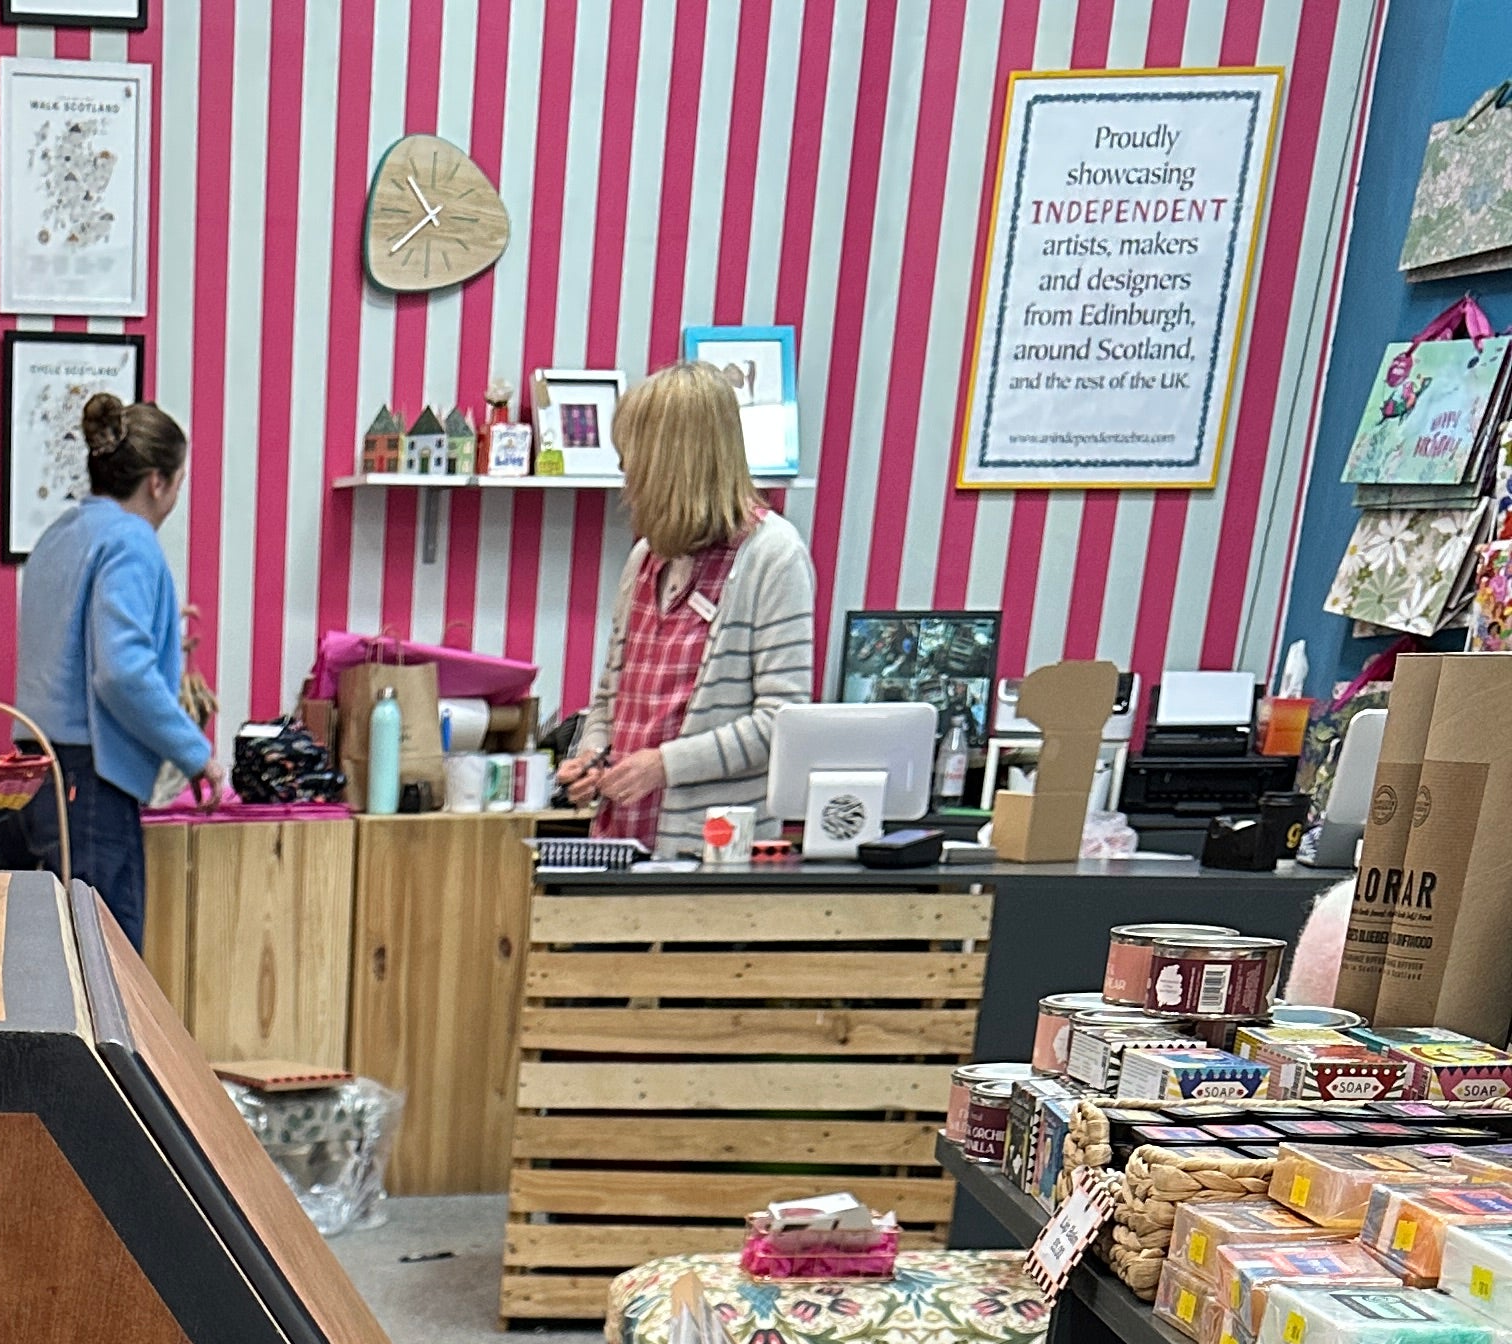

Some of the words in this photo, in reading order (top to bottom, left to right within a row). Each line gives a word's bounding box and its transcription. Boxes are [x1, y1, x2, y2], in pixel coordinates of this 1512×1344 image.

[29, 100, 60, 110] WALK
[63, 100, 120, 113] SCOTLAND
[1095, 123, 1181, 155] Proudly
[1066, 161, 1196, 191] showcasing
[1031, 198, 1228, 224] INDEPENDENT
[1042, 234, 1112, 258] artists,
[1119, 231, 1199, 256] makers
[1038, 267, 1082, 291] and
[1087, 267, 1192, 298] designers
[1023, 302, 1073, 327] from
[1080, 301, 1196, 333] Edinburgh,
[1013, 337, 1091, 361] around
[1096, 337, 1196, 362] Scotland,
[1009, 372, 1042, 390] and
[1045, 372, 1071, 390] the
[1075, 374, 1104, 390] rest
[1109, 371, 1130, 390] of
[1130, 372, 1157, 390] the
[1204, 1085, 1236, 1099] SOAP
[1339, 1081, 1371, 1094] SOAP
[1463, 1084, 1497, 1098] SOAP
